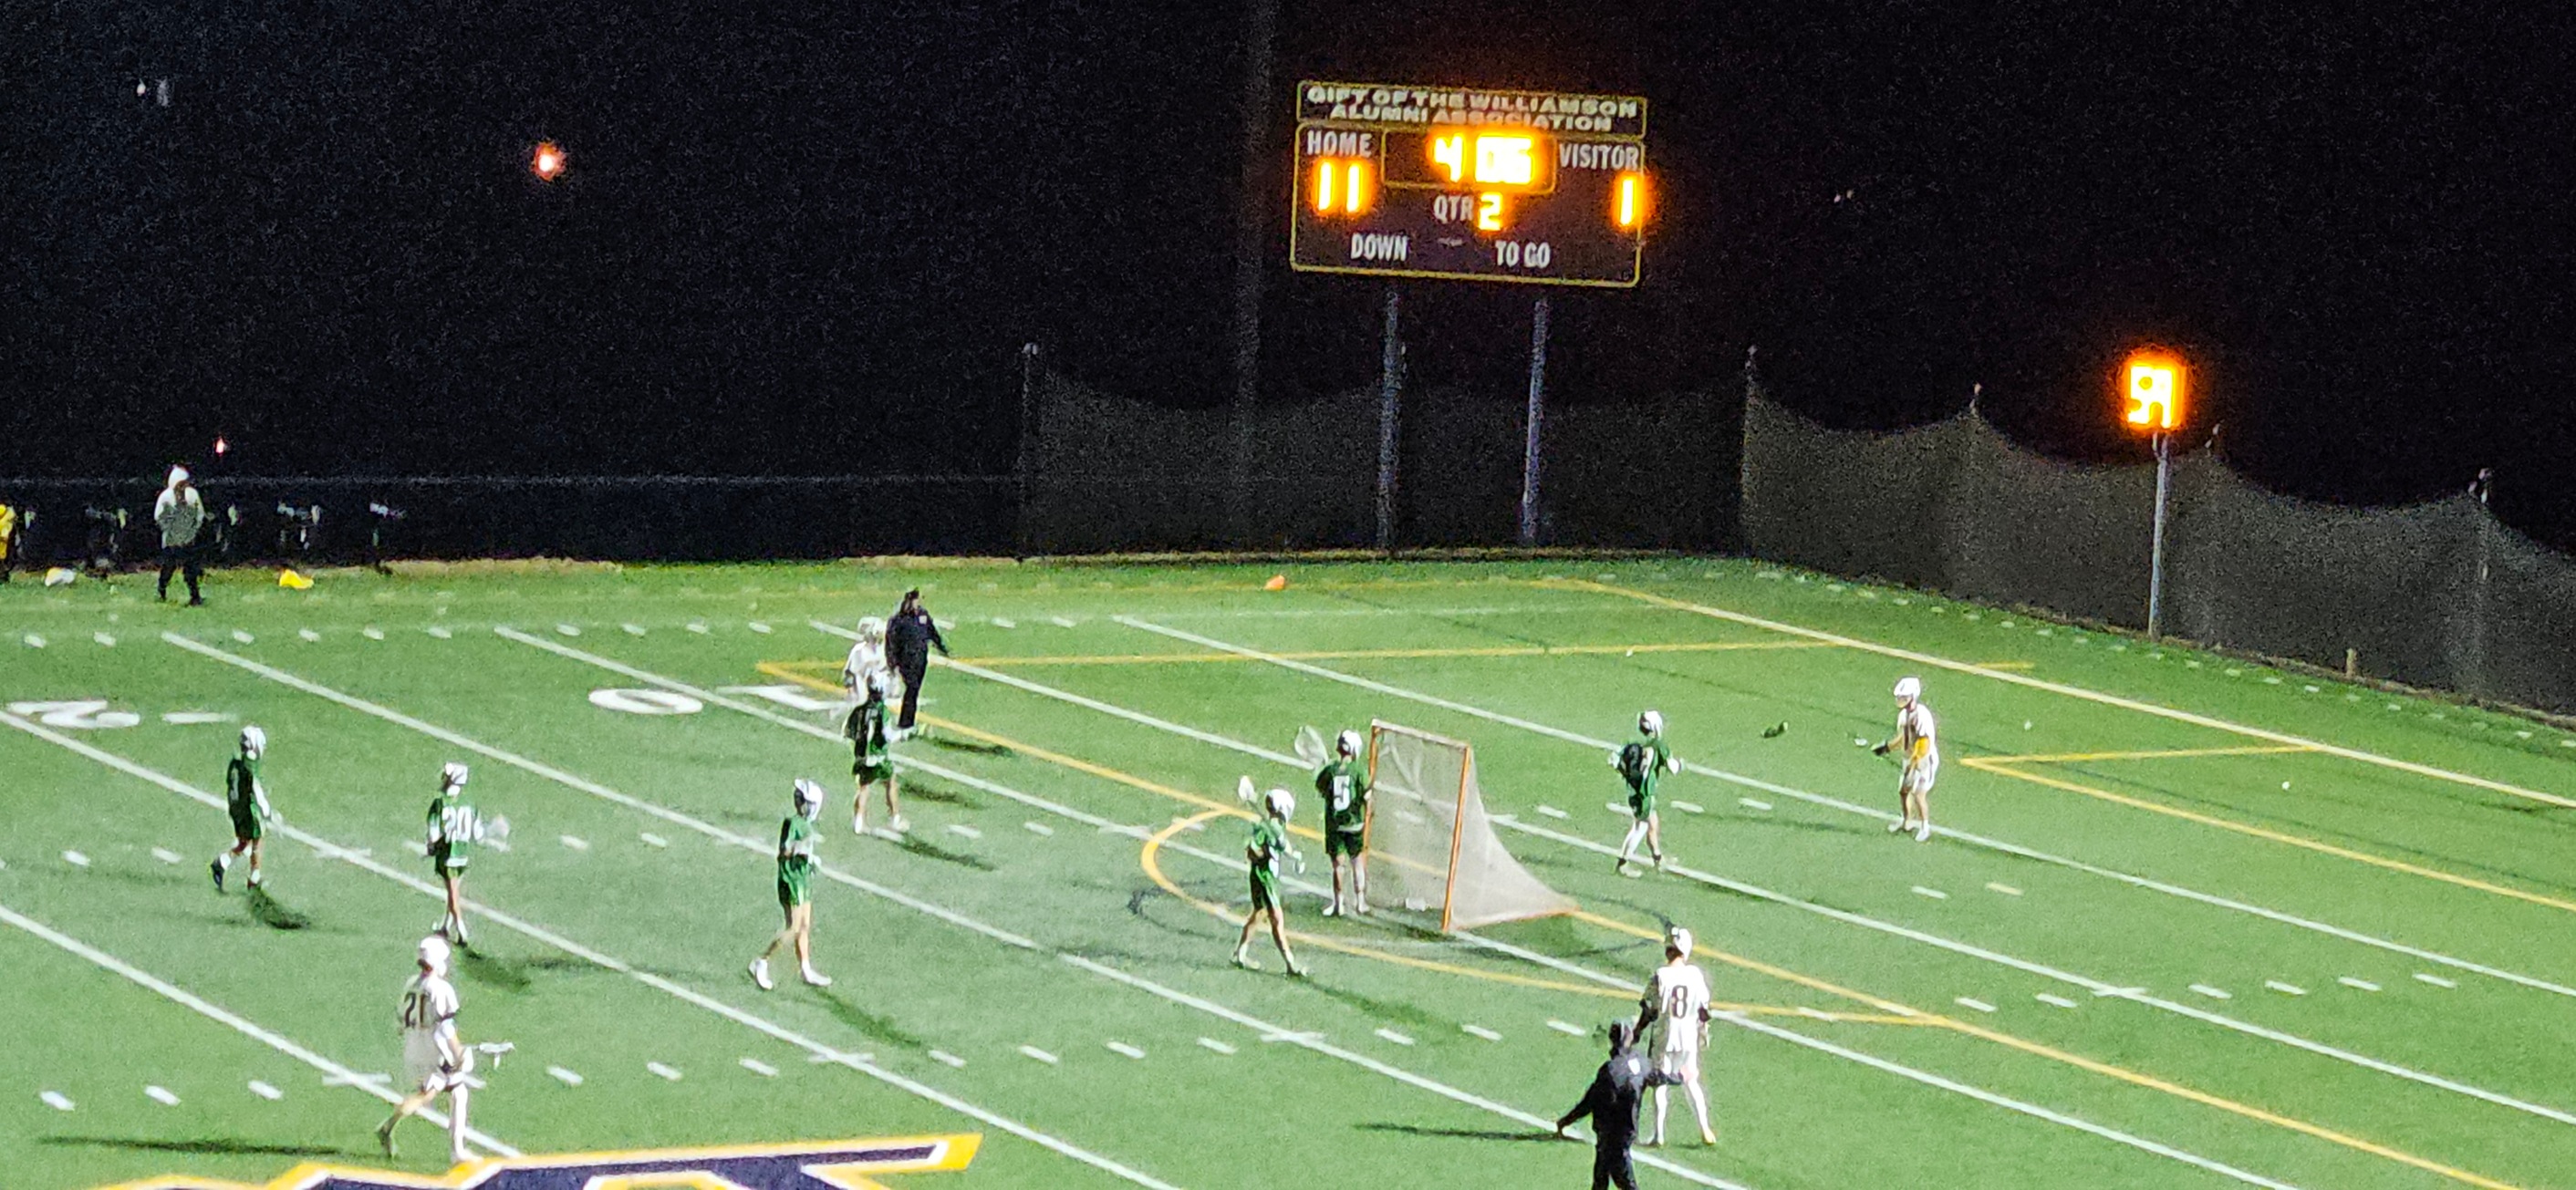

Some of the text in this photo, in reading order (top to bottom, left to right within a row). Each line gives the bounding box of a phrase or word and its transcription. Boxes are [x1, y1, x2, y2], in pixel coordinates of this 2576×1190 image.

[1307, 86, 1637, 119] GIFT OF THE WILLIAMSON
[1330, 104, 1612, 132] ALUMNI ASSOCIATION
[1307, 129, 1372, 157] HOME
[1559, 142, 1639, 171] VISITOR
[1317, 161, 1361, 213] 11
[1620, 178, 1634, 226] 1
[1433, 194, 1474, 224] QTR
[1478, 192, 1503, 232] 2
[1350, 232, 1408, 262] DOWN
[1494, 240, 1551, 269] TO GO
[1333, 774, 1351, 812] 5
